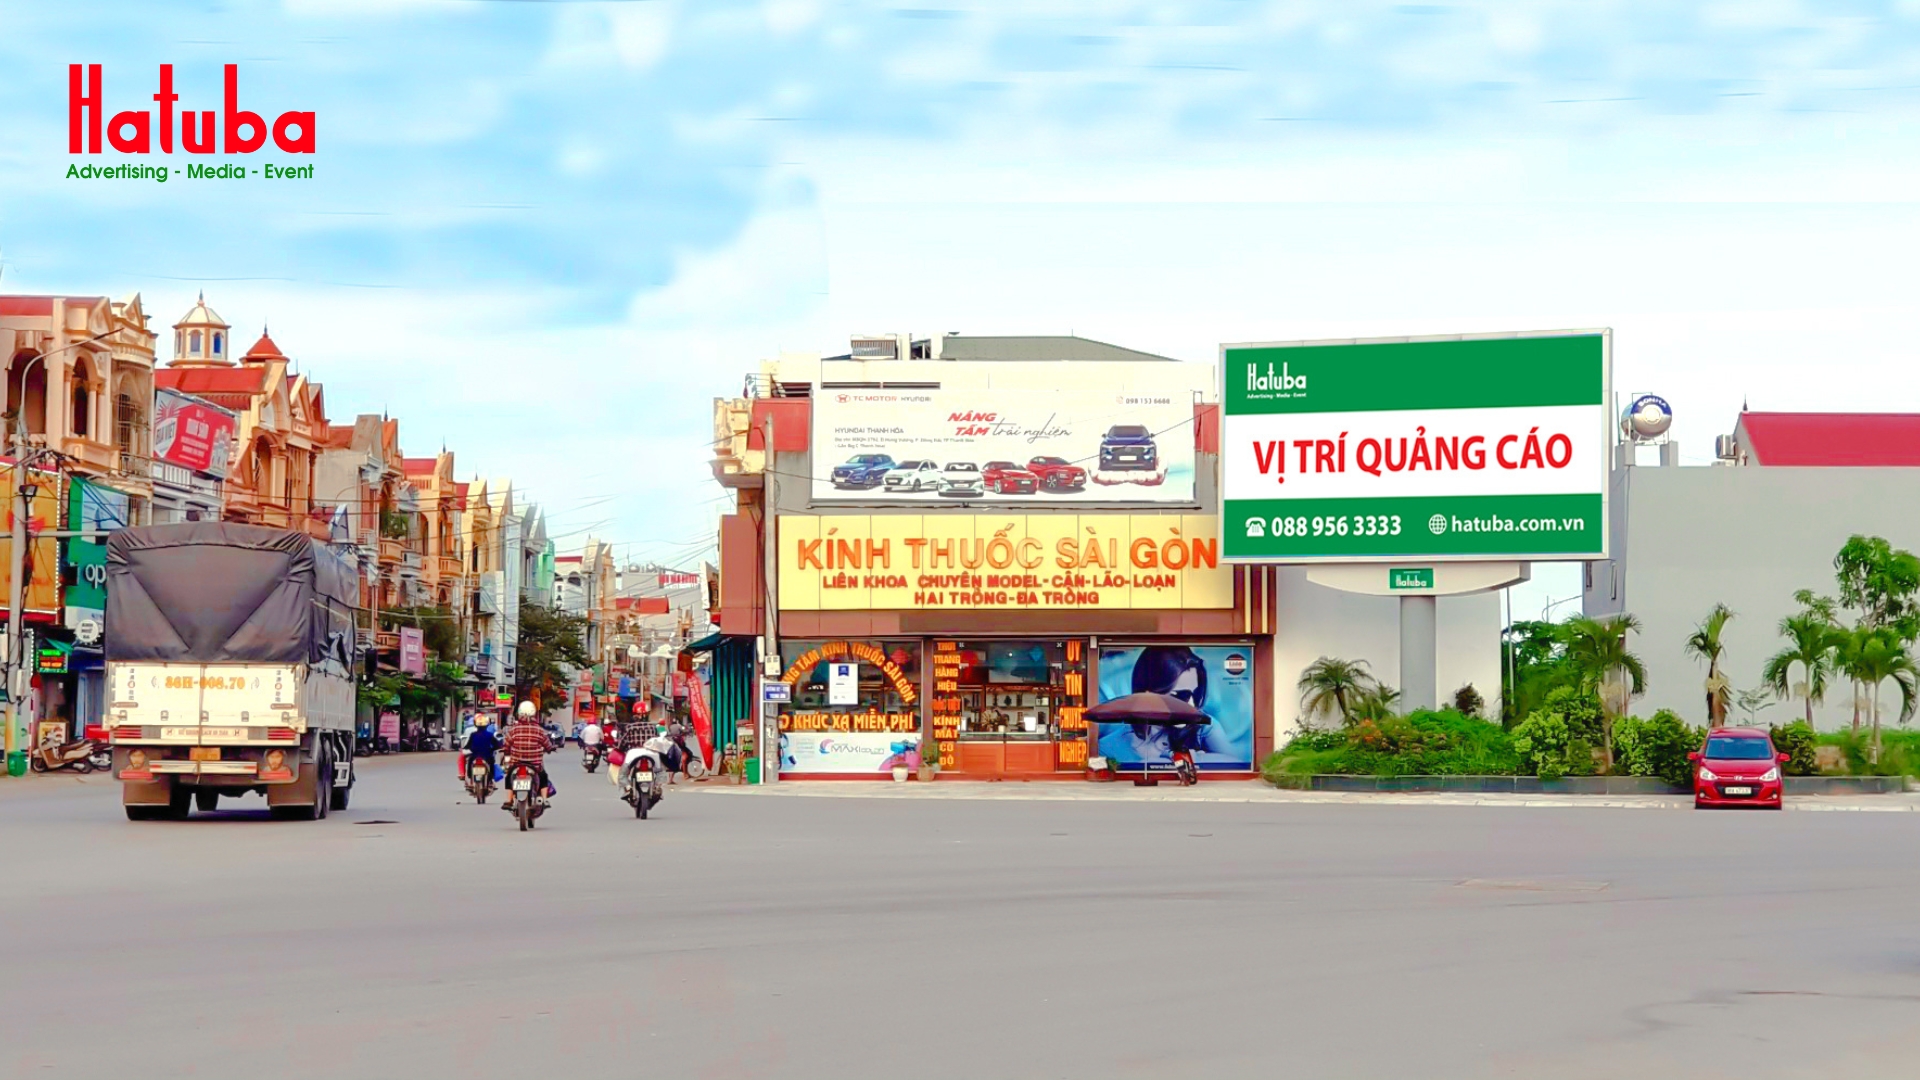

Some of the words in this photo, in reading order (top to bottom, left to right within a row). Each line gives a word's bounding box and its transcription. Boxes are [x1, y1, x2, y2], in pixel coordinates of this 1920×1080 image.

[1247, 361, 1307, 391] Hatuba
[1252, 440, 1286, 485] VỊ
[1293, 431, 1349, 473] TRÍ
[1356, 425, 1486, 478] QUẢNG
[1496, 426, 1573, 470] CÁO
[1271, 516, 1308, 537] 088
[1311, 515, 1349, 537] 956
[1353, 514, 1402, 536] 3333
[1451, 514, 1585, 533] hatuba.com.vn
[798, 527, 890, 570] KÍNH
[904, 523, 1044, 570] THUỐC
[1055, 526, 1117, 570] SÀI
[1130, 527, 1217, 570] GÒN
[822, 571, 858, 589] LIÊN
[863, 575, 908, 589] KHOA
[917, 570, 982, 589] CHUYÊN
[914, 591, 943, 605] HAI
[933, 654, 961, 664] TRANG
[1066, 640, 1080, 661] UY
[935, 667, 958, 677] HÀNG
[937, 680, 957, 693] HIỆU
[1064, 670, 1082, 696] TÍN
[794, 711, 829, 729] KHÚC
[832, 713, 850, 732] XẠ
[890, 711, 914, 729] PHÍ
[933, 715, 960, 726] KÍNH
